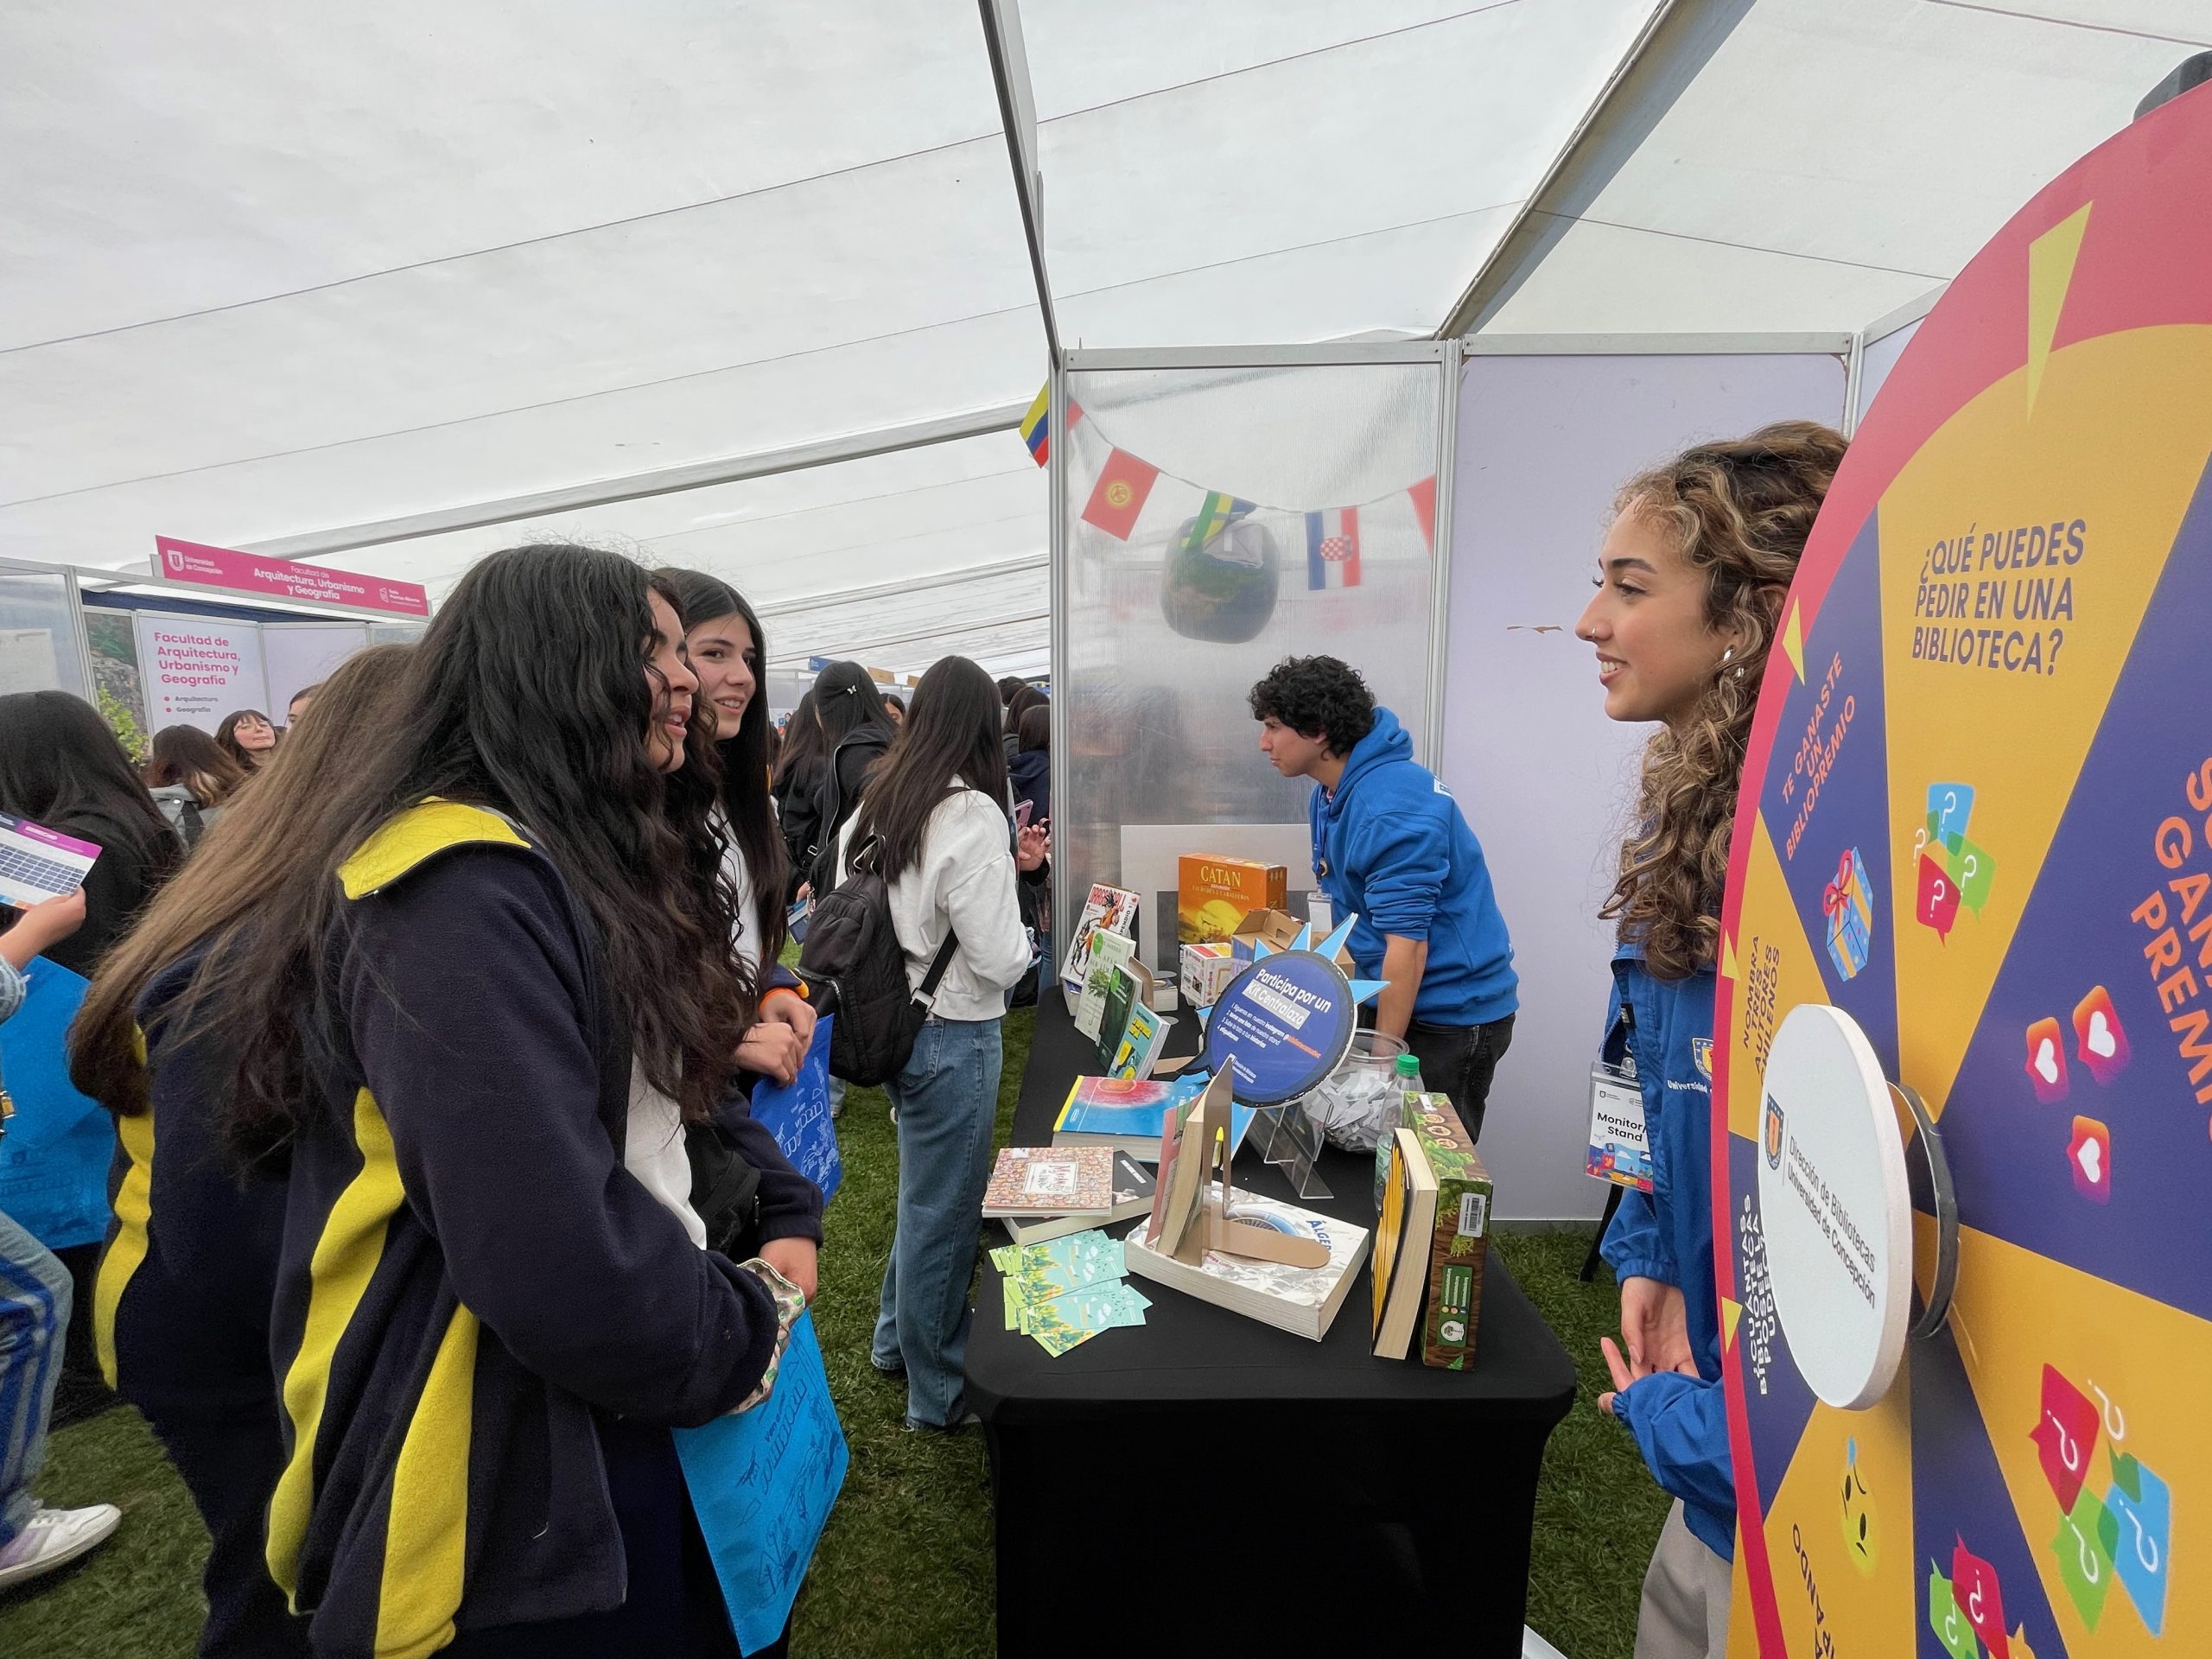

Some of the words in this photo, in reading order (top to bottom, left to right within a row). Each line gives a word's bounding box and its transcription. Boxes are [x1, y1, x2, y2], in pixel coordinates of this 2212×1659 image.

[290, 566, 320, 577] Facultad
[320, 570, 330, 579] de
[1919, 522, 1977, 584] ¿QUÉ
[1979, 518, 2086, 571] PUEDES
[253, 568, 317, 588] Arquitectura,
[318, 578, 365, 594] Urbanismo
[286, 584, 294, 595] y
[295, 585, 340, 601] Geografía
[1915, 582, 1969, 618] PEDIR
[1974, 580, 2007, 620] EN
[2012, 577, 2073, 620] UNA
[154, 632, 213, 645] Facultad
[214, 637, 229, 647] de
[157, 646, 241, 662] Arquitectura,
[1911, 626, 2063, 676] BIBLIOTECA?
[158, 659, 230, 672] Urbanismo
[232, 665, 238, 676] y
[161, 674, 226, 687] Geografía
[1782, 772, 1795, 804] TE
[1795, 651, 1843, 775] GANASTE
[1786, 695, 1855, 861] BIBLIOPREMIO
[1807, 736, 1823, 777] UN
[1200, 865, 1242, 887] CATAN
[1120, 910, 1131, 934] PENDIO
[1248, 982, 1261, 997] Kit
[1258, 989, 1306, 1026] Centralazo
[1255, 968, 1299, 996] Participa
[1293, 988, 1318, 1005] por
[1314, 997, 1332, 1014] un
[1743, 936, 1759, 1049] NOMBRA
[1751, 967, 1763, 1031] TRES
[1755, 944, 1772, 1074] AUTORES
[1760, 946, 1780, 1086] CHILENOS
[2130, 890, 2212, 1136] PREMI
[1667, 1079, 1708, 1093] Universidad
[1597, 1111, 1647, 1134] Monitor/
[1607, 1126, 1643, 1142] Stand
[1789, 1135, 1819, 1193] Dirección
[1820, 1181, 1830, 1207] de
[1830, 1192, 1876, 1274] Bibliotecas
[1306, 1220, 1332, 1250] ÁLGE
[1753, 1213, 1762, 1252] LA
[1787, 1161, 1821, 1225] Universidad
[1821, 1216, 1831, 1239] de
[1831, 1228, 1875, 1309] Concepción
[1744, 1194, 1768, 1395] BIBLIOTECAS
[1756, 1262, 1771, 1363] POSEE
